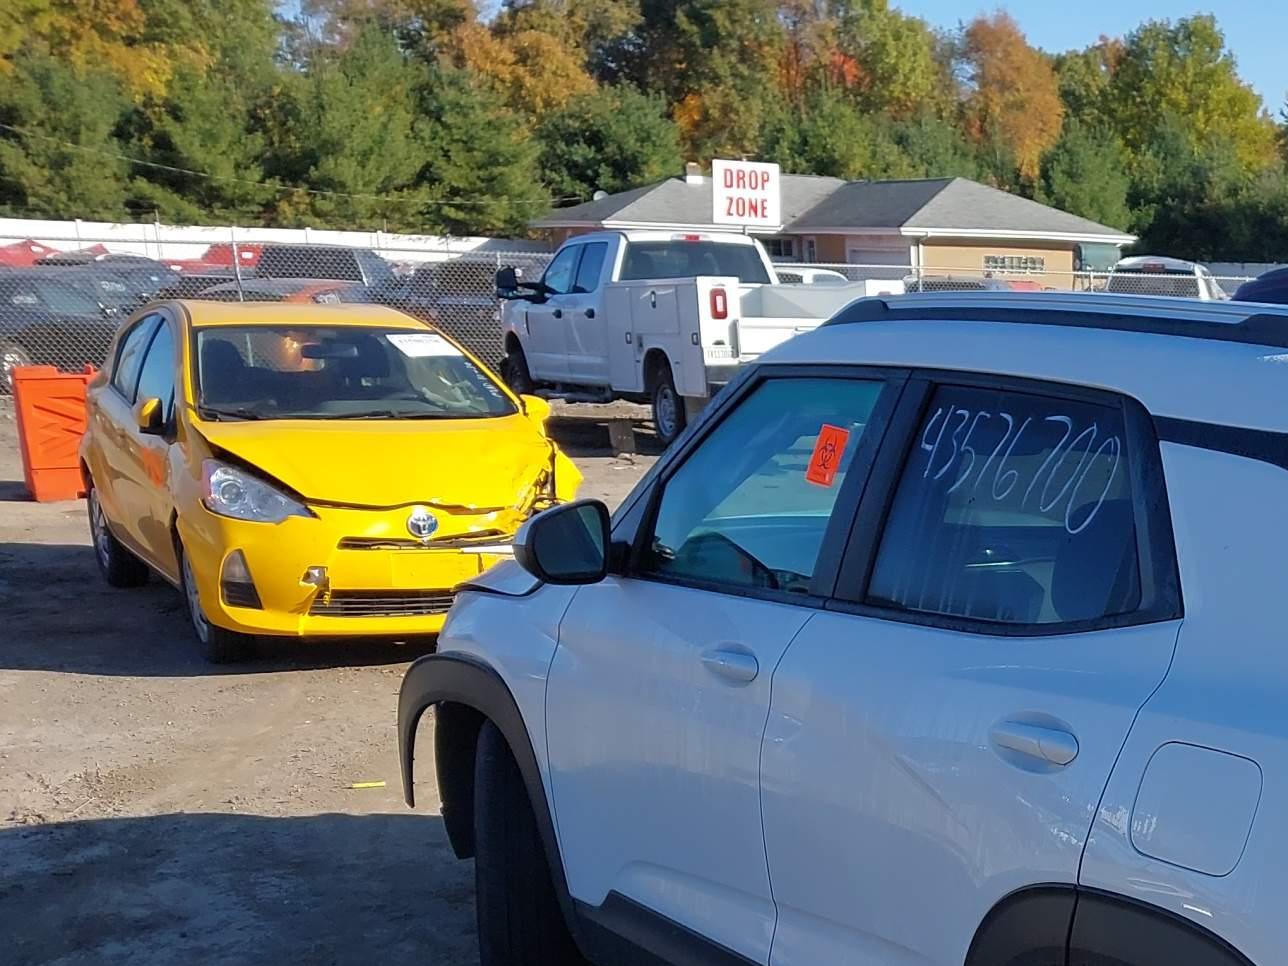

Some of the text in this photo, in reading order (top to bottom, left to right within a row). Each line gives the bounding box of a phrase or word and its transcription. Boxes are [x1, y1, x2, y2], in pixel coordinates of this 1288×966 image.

[723, 168, 770, 190] DROP
[726, 196, 768, 218] ZONE
[920, 404, 1121, 534] 43576700
